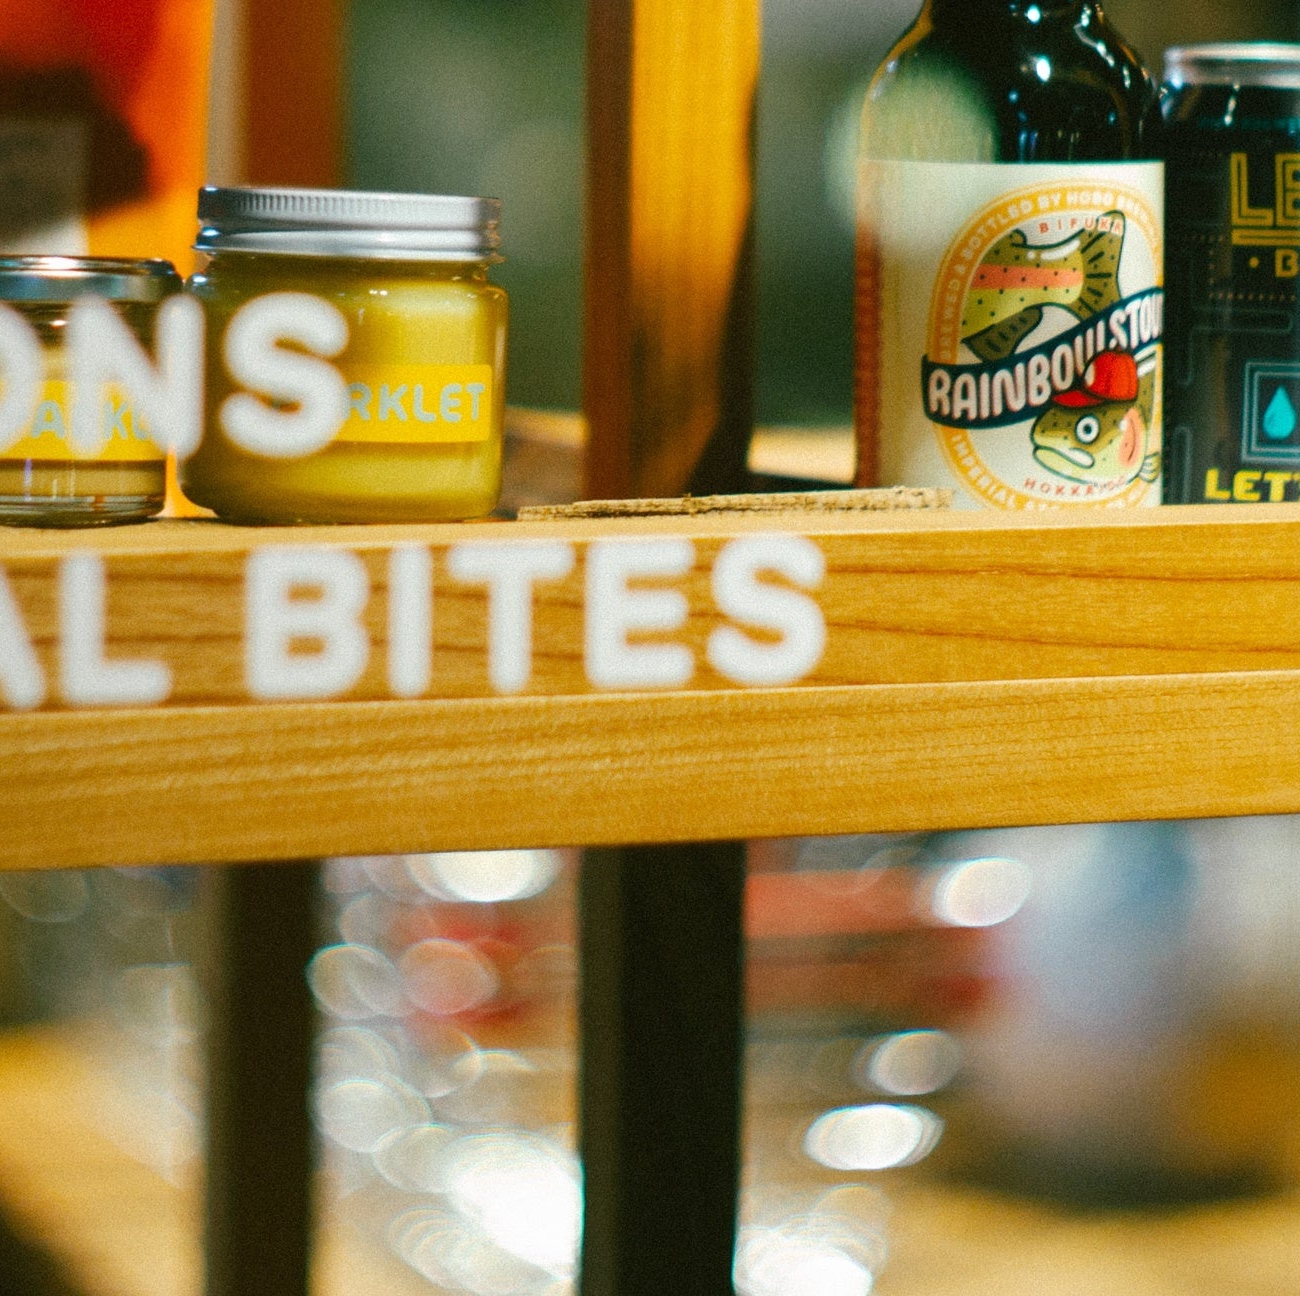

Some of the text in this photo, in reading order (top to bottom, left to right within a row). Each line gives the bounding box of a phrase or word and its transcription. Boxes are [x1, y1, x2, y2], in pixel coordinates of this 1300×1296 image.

[1039, 216, 1123, 235] BIFUKA
[340, 381, 486, 423] RKLET
[928, 319, 1106, 421] RAINBOW
[243, 533, 828, 701] BITES
